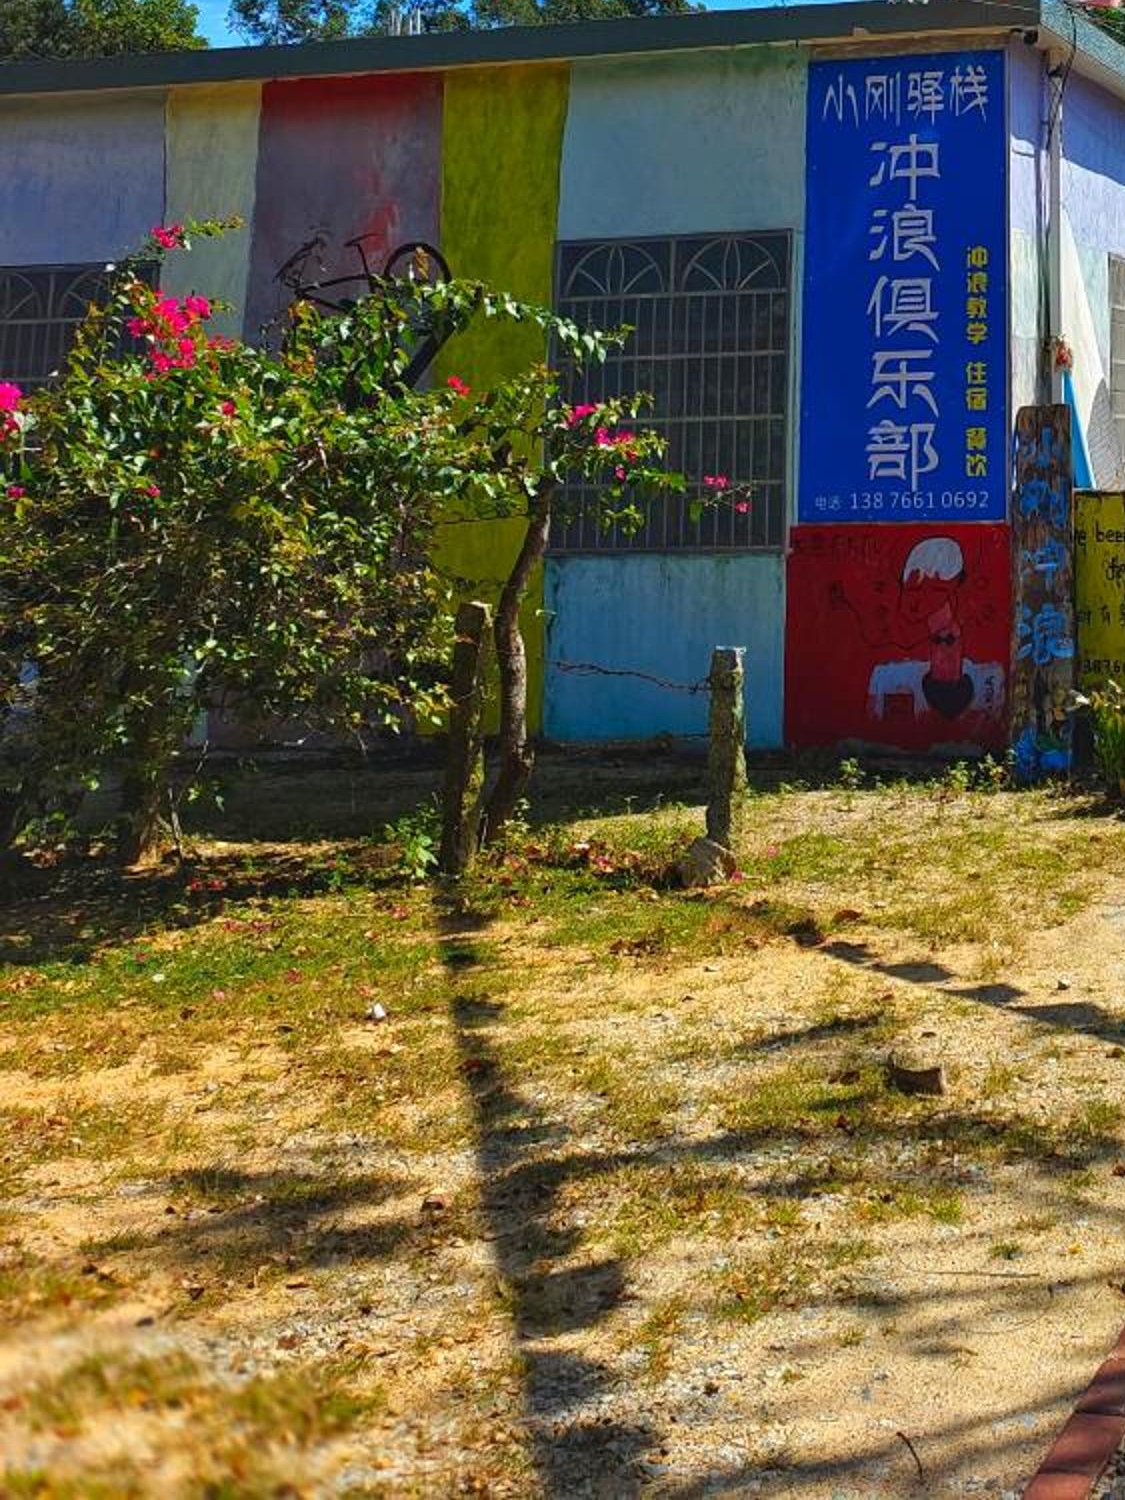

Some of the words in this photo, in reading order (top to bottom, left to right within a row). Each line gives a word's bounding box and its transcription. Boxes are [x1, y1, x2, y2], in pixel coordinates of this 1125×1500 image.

[866, 133, 940, 491] 冲浪俱乐部
[966, 246, 988, 344] 冲浪教学
[966, 361, 988, 411] 住宿
[850, 492, 883, 509] 138
[890, 492, 935, 509] 7661
[941, 491, 989, 509] 0692
